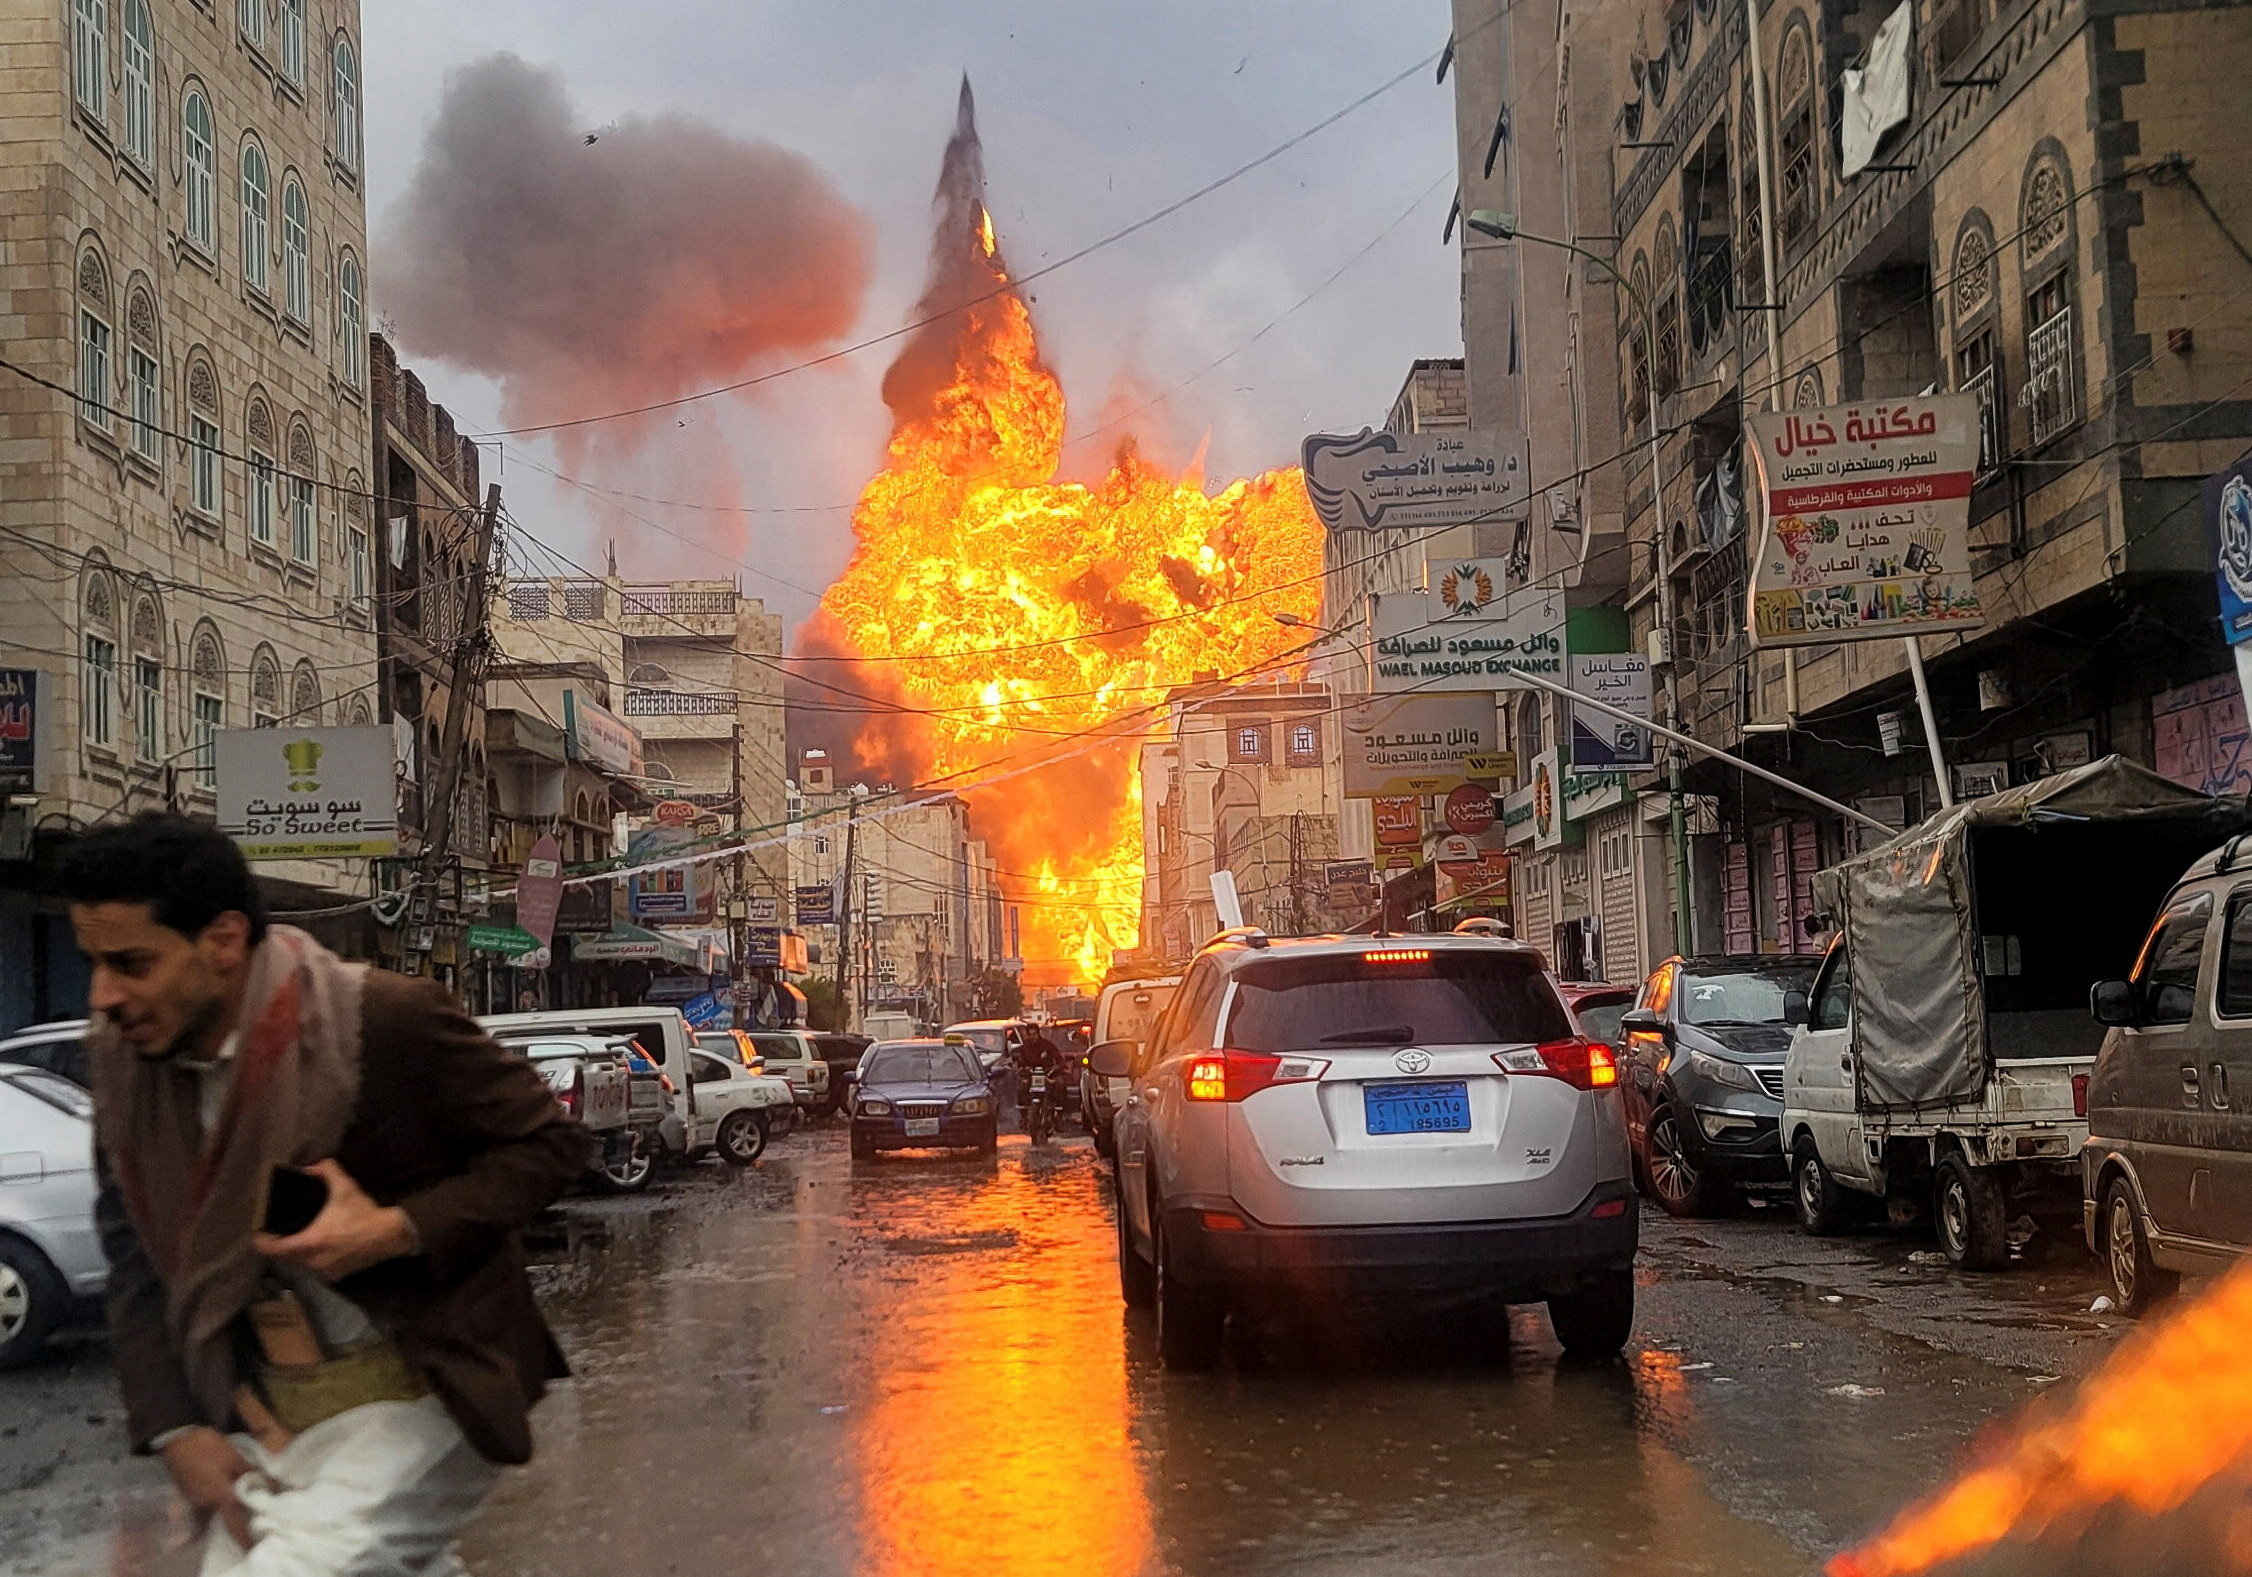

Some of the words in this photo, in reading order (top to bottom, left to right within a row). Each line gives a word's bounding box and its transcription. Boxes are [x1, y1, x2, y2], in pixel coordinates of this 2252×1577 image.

[1774, 412, 1837, 457] خيال
[1846, 406, 1937, 450] مكتبة
[1436, 437, 1464, 452] عيادة
[1362, 453, 1435, 487] الأصبحي
[1442, 456, 1495, 478] وهيب
[1782, 463, 1823, 481] التجميل
[1826, 457, 1895, 479] ومستحضرات
[1369, 484, 1403, 500] الأسنان
[1446, 483, 1478, 497] وتقويم
[1846, 487, 1888, 503] المكتبية
[1891, 484, 1933, 499] والأدوات
[1787, 492, 1844, 508] والقرطاسية
[1875, 509, 1915, 527] تحف
[1846, 533, 1890, 551] هدايا
[1377, 635, 1442, 659] للصرافة
[1447, 638, 1514, 656] مسعود
[1520, 633, 1560, 654] وائل
[1377, 662, 1418, 678] WAEL
[1420, 660, 1483, 677] MASOUD
[1486, 658, 1561, 675] EXCHANGE
[1582, 657, 1645, 677] مغاسل
[1595, 674, 1632, 691] الخير
[1364, 731, 1442, 749] مسعود
[1447, 728, 1479, 748] وائل
[1366, 751, 1428, 766] والتحويلات
[246, 799, 321, 823] سويت
[326, 800, 362, 821] سو
[246, 819, 276, 836] So
[285, 818, 362, 835] Sweet
[1377, 806, 1417, 834] البلدي
[1411, 1116, 1460, 1130] 195695
